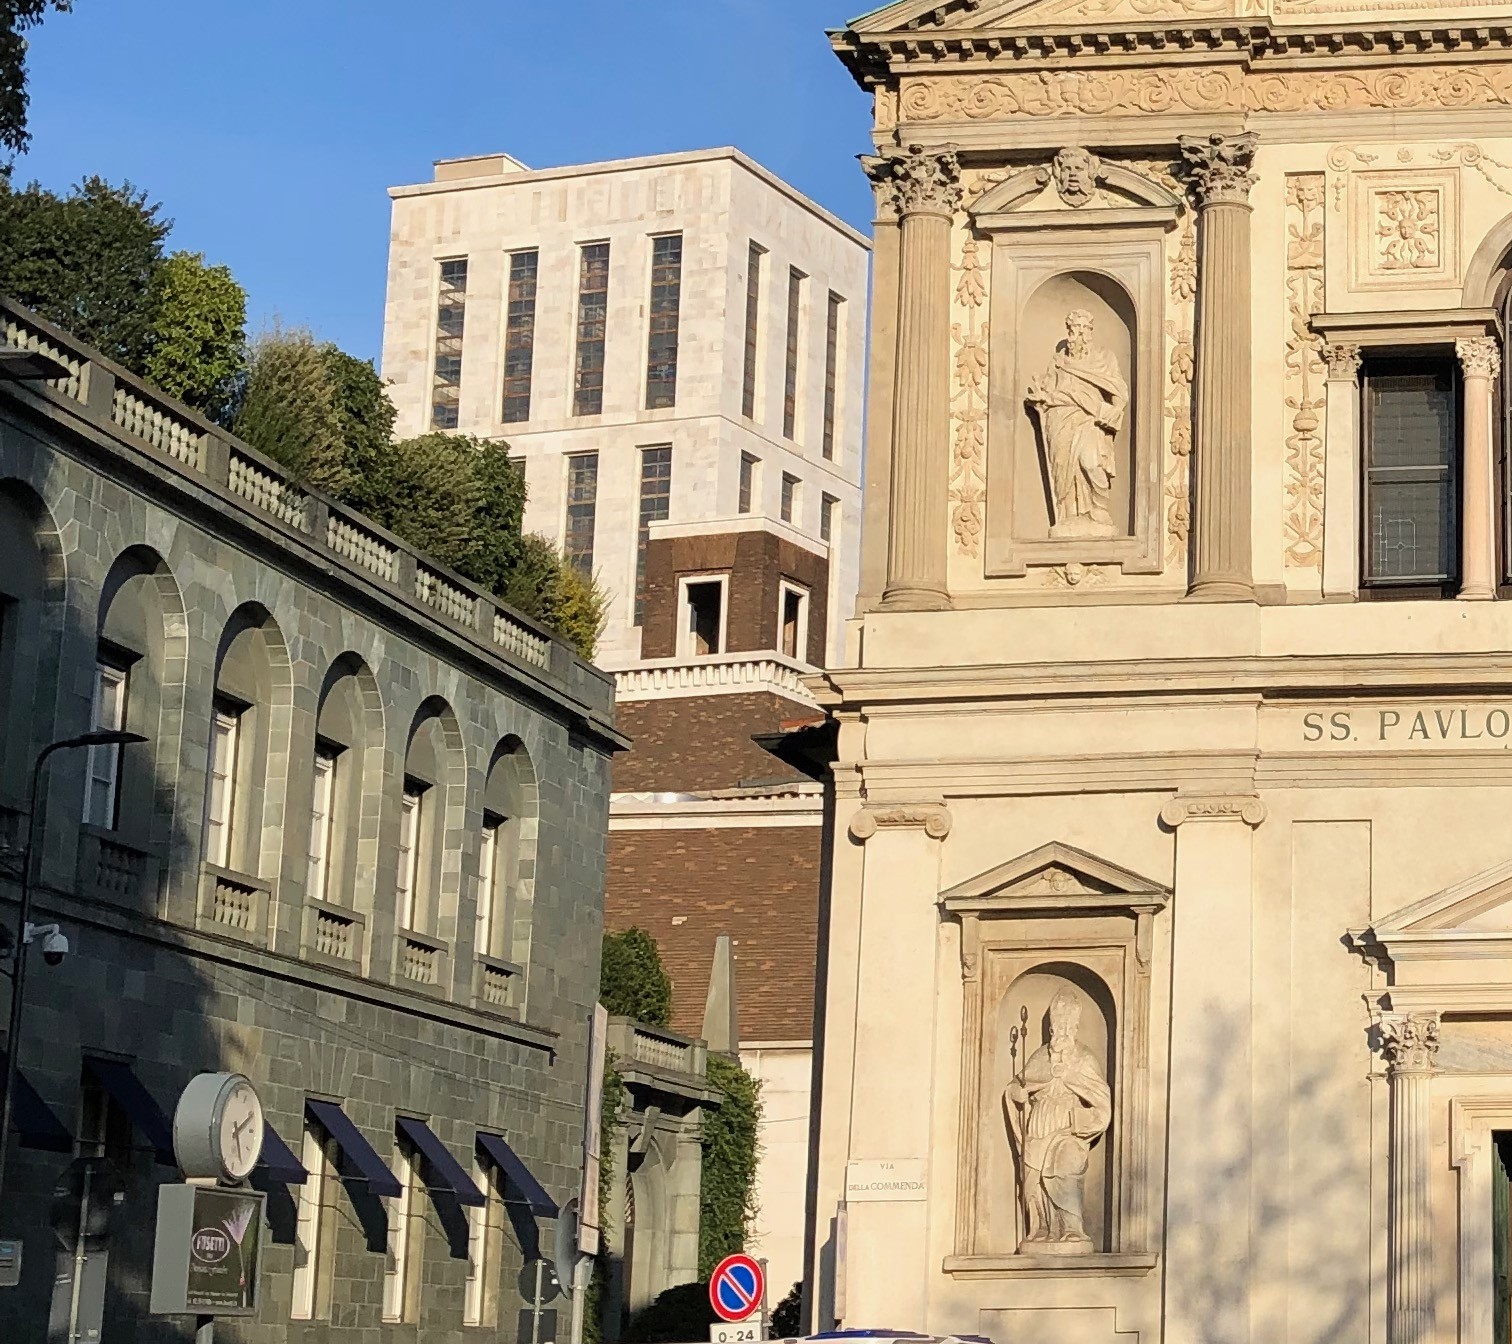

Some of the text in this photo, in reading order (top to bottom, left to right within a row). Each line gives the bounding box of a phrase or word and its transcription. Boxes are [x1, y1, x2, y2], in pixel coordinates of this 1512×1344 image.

[1303, 711, 1359, 742] SS.
[1378, 708, 1511, 741] PAVLO
[870, 1182, 924, 1191] COMMENDA
